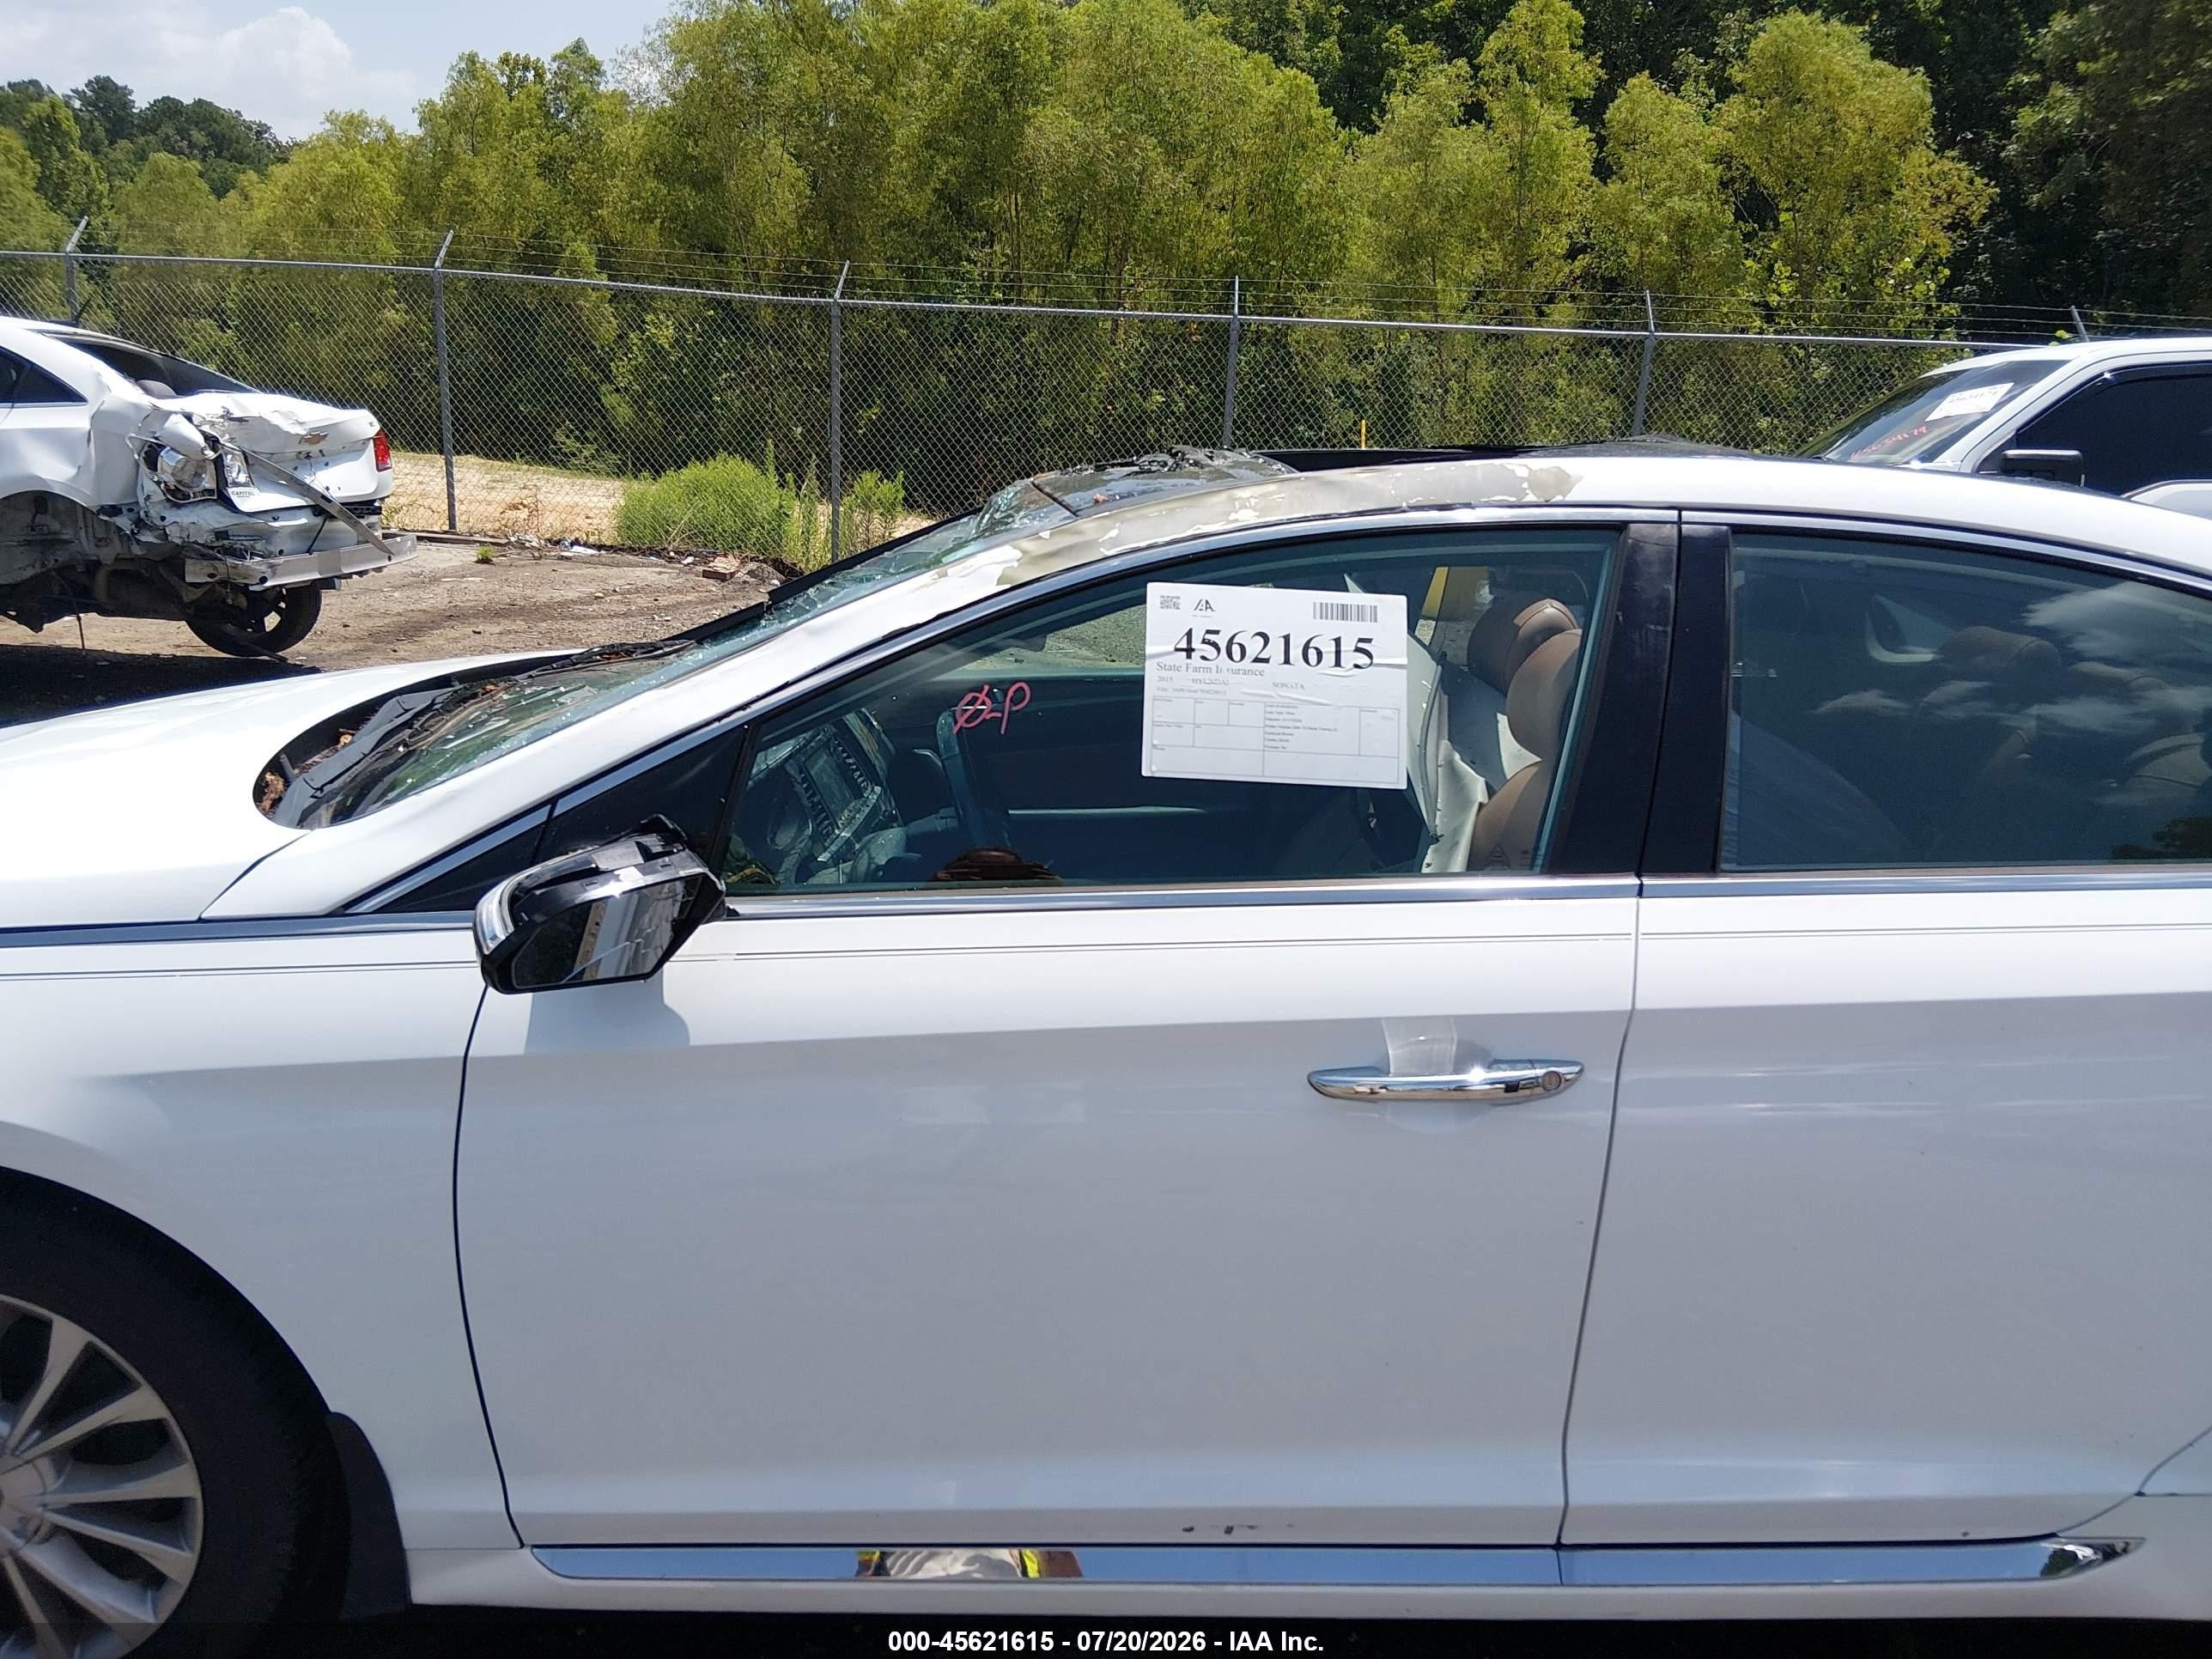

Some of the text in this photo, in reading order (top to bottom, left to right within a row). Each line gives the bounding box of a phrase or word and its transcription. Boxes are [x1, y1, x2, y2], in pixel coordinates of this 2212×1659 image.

[1173, 628, 1374, 670] 45621615
[1156, 661, 1182, 672] State
[1186, 663, 1212, 674] Farm
